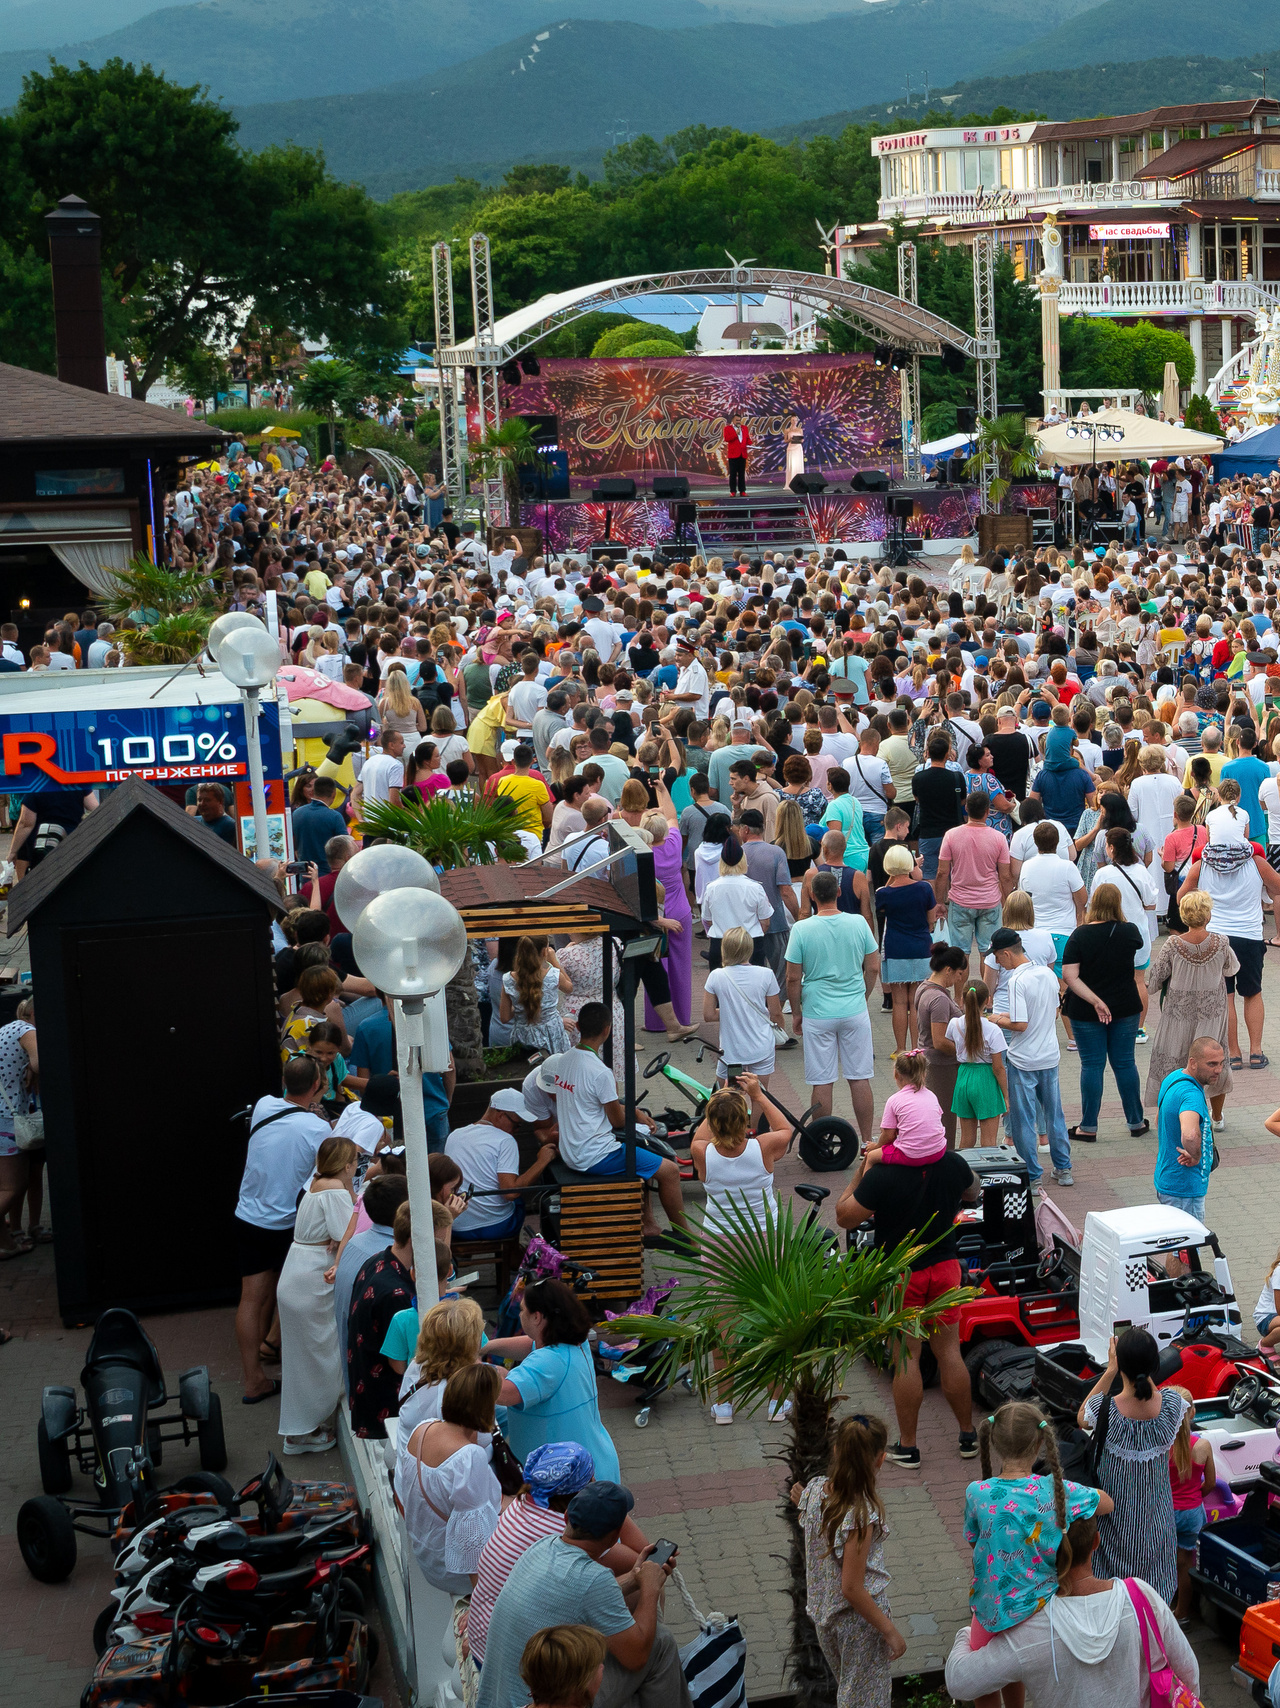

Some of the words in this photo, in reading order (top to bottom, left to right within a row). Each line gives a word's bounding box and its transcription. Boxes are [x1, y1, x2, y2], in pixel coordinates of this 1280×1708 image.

[877, 134, 928, 152] БОУЛИНГ
[962, 128, 1021, 143] КЛУБ
[1072, 179, 1143, 199] disco
[1120, 225, 1163, 237] свадьбы,
[97, 731, 237, 766] 100%
